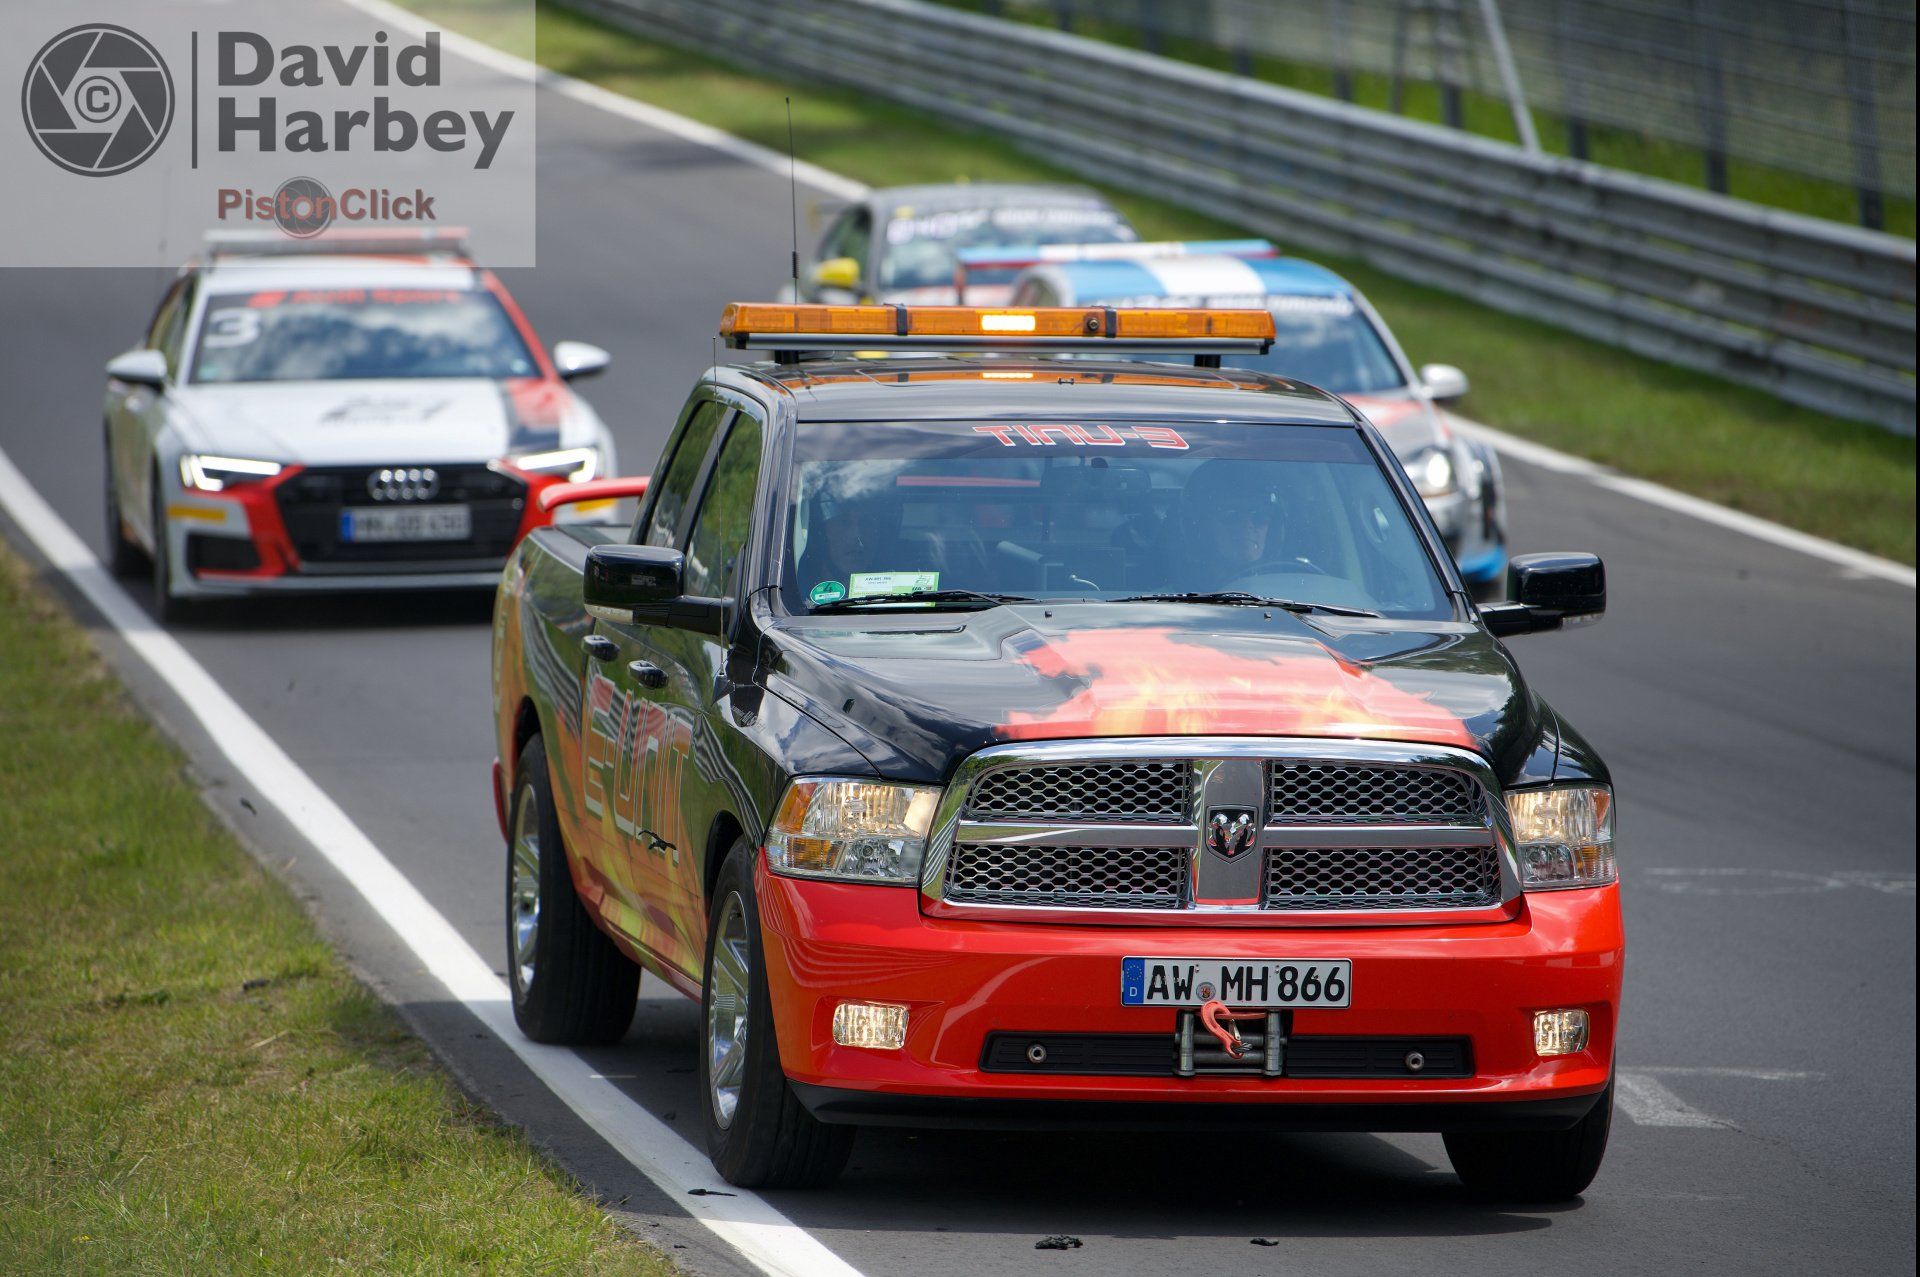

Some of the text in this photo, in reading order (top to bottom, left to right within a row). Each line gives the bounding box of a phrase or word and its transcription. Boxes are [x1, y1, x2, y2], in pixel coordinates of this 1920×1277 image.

[203, 308, 262, 348] 3
[1129, 986, 1138, 997] D
[1146, 965, 1345, 1001] AW MH 866
